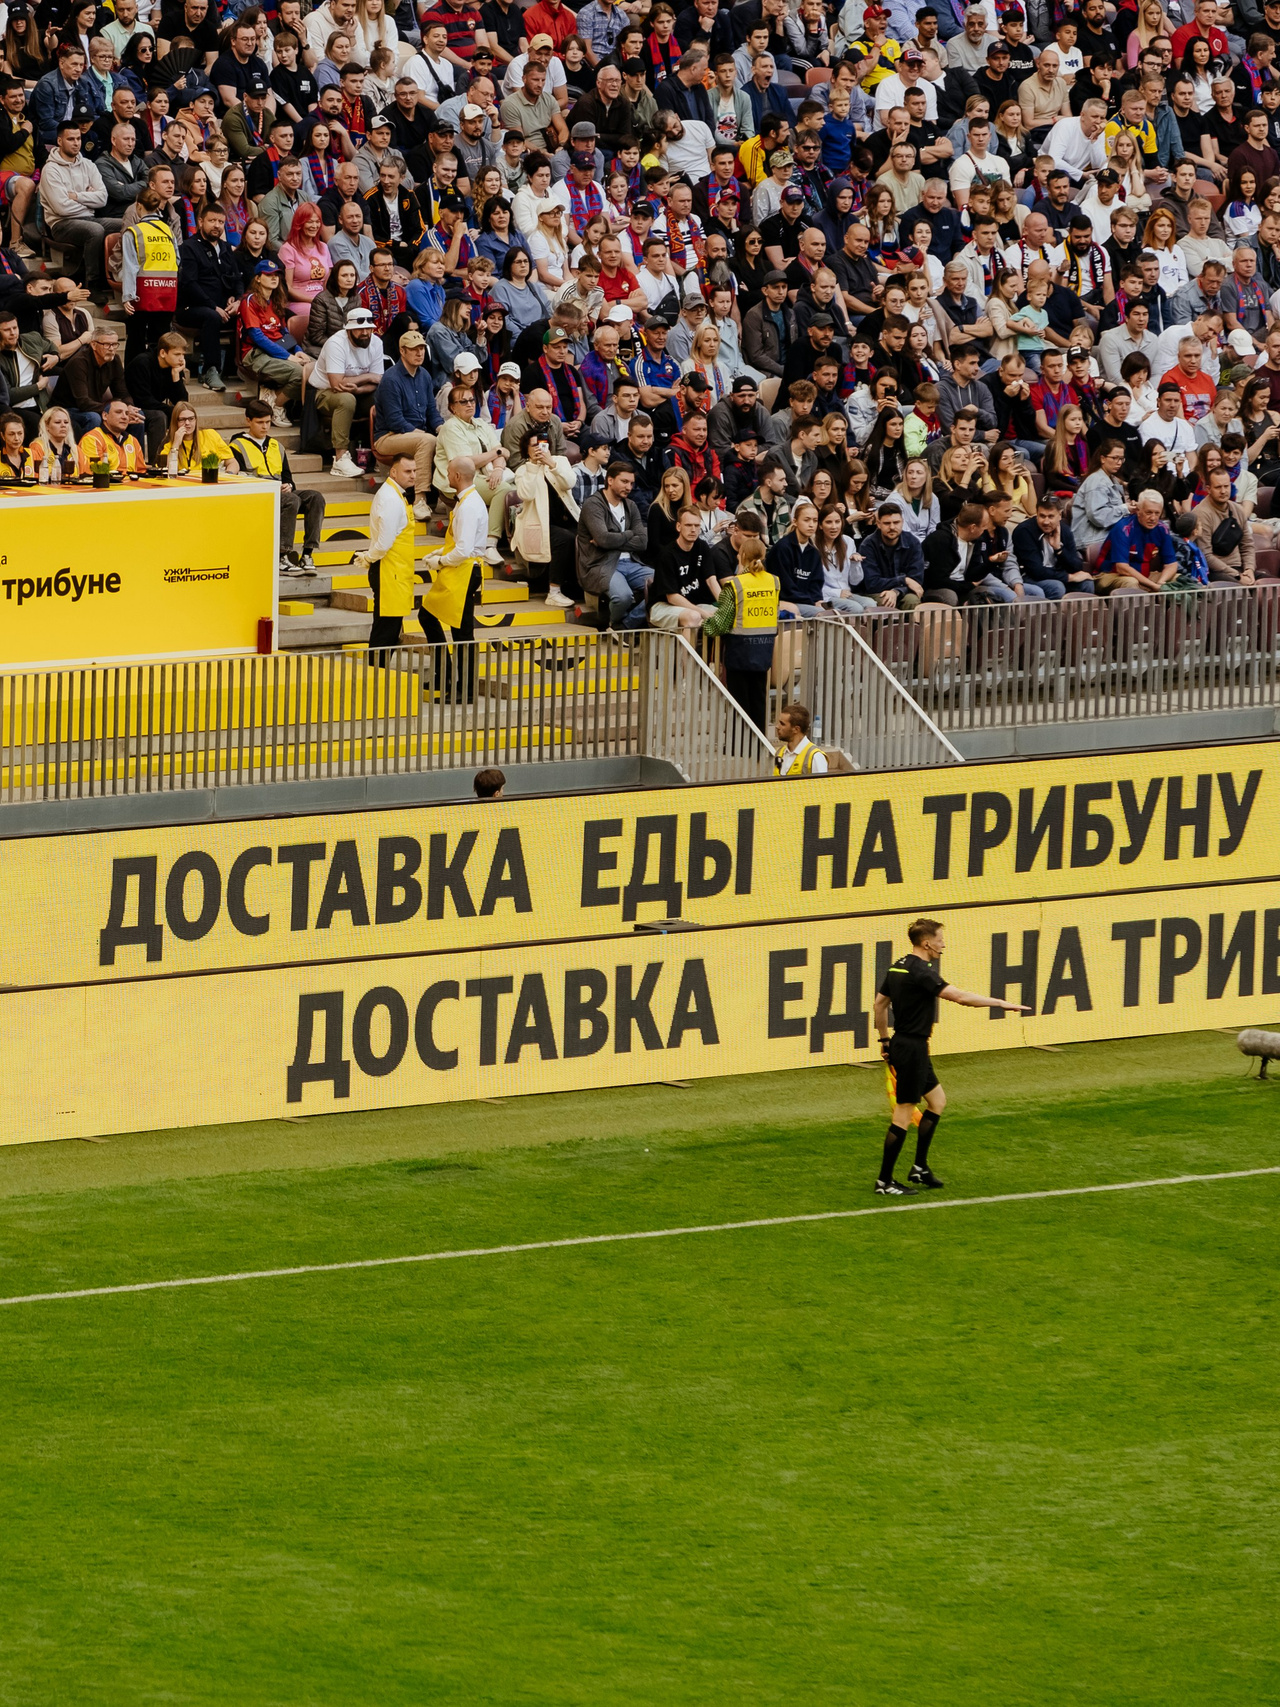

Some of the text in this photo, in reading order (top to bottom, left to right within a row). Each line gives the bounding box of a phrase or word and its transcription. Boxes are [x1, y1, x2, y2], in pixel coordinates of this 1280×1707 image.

[1, 567, 122, 606] трибуне
[163, 572, 230, 583] ЧЕМПИОНОВ
[746, 589, 774, 599] SAFETY
[743, 636, 775, 645] STEWAR
[99, 769, 1264, 966] ДОСТАВКА ЕДЫ НА ТРИБУНУ
[286, 958, 720, 1103] ДОСТАВКА
[989, 925, 1094, 1020] НА
